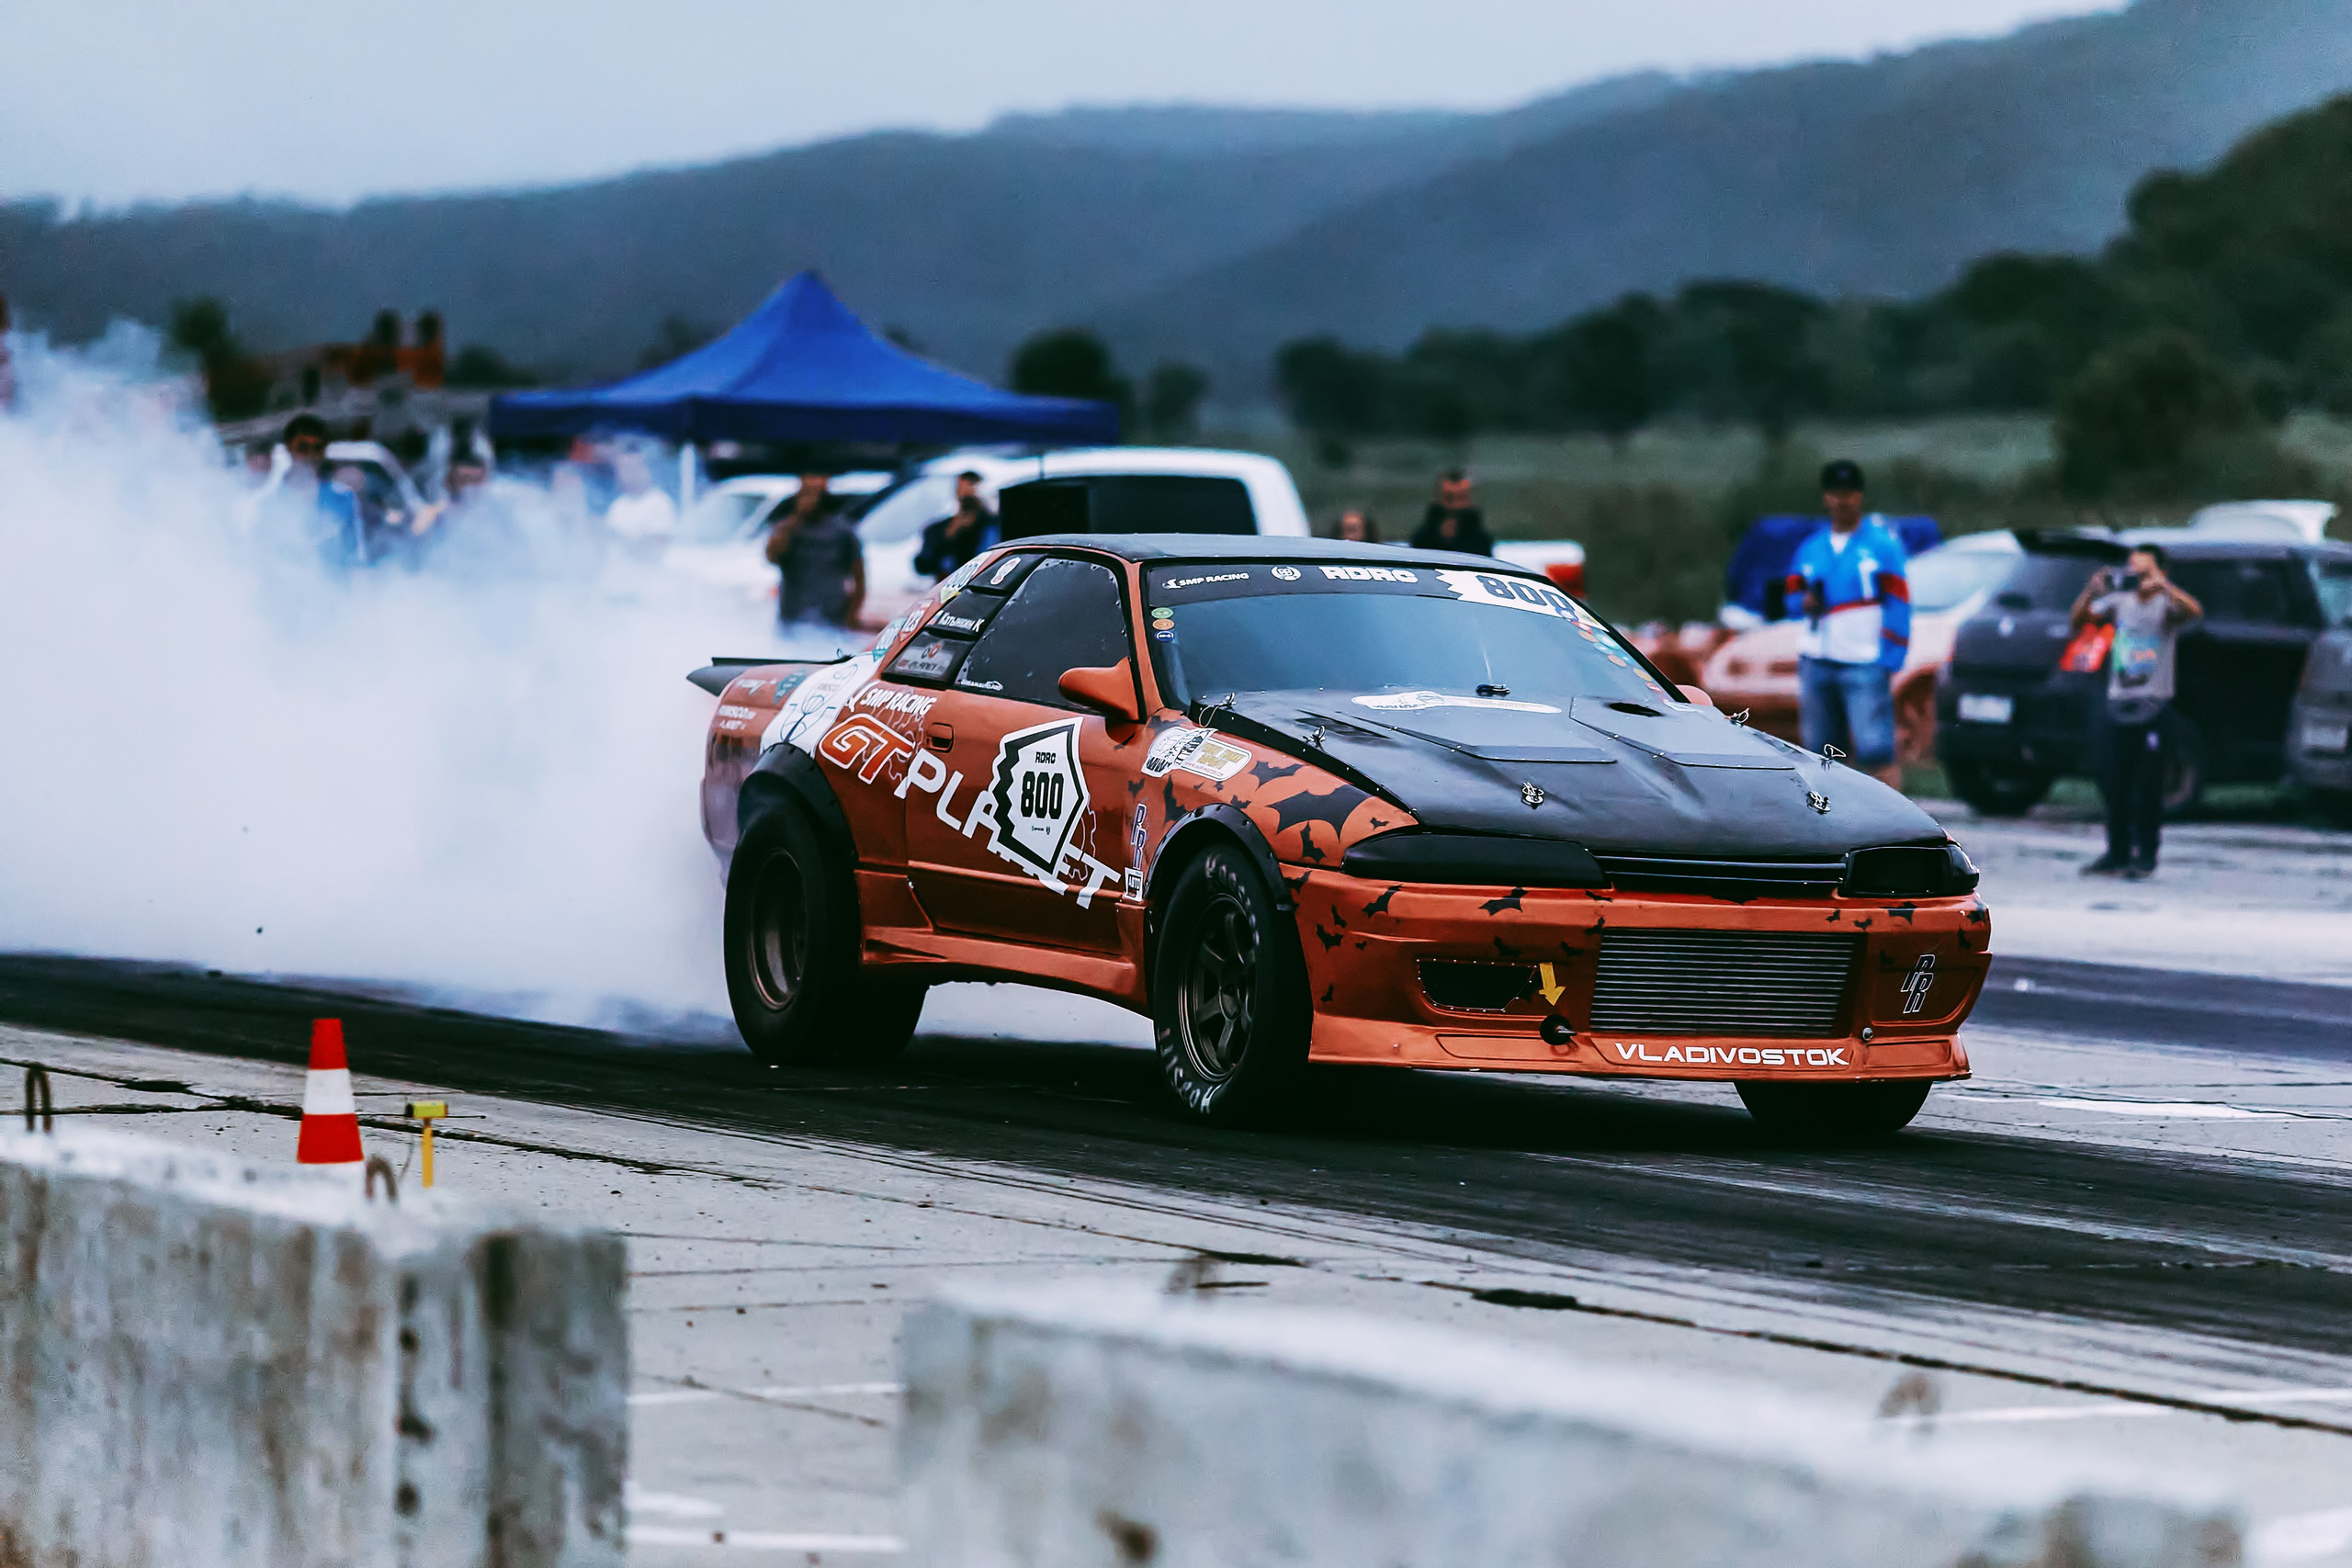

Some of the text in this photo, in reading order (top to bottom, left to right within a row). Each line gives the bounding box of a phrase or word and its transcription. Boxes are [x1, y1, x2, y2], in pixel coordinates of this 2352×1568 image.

[1178, 572, 1250, 587] SMP RACING
[1317, 566, 1419, 583] RDRC
[1476, 574, 1577, 616] 800
[861, 688, 938, 716] SMP RACING
[819, 713, 916, 785] GT
[1035, 751, 1057, 764] RDRC
[1021, 771, 1064, 819] 800
[1615, 1043, 1849, 1066] VLADIVOSTOK
